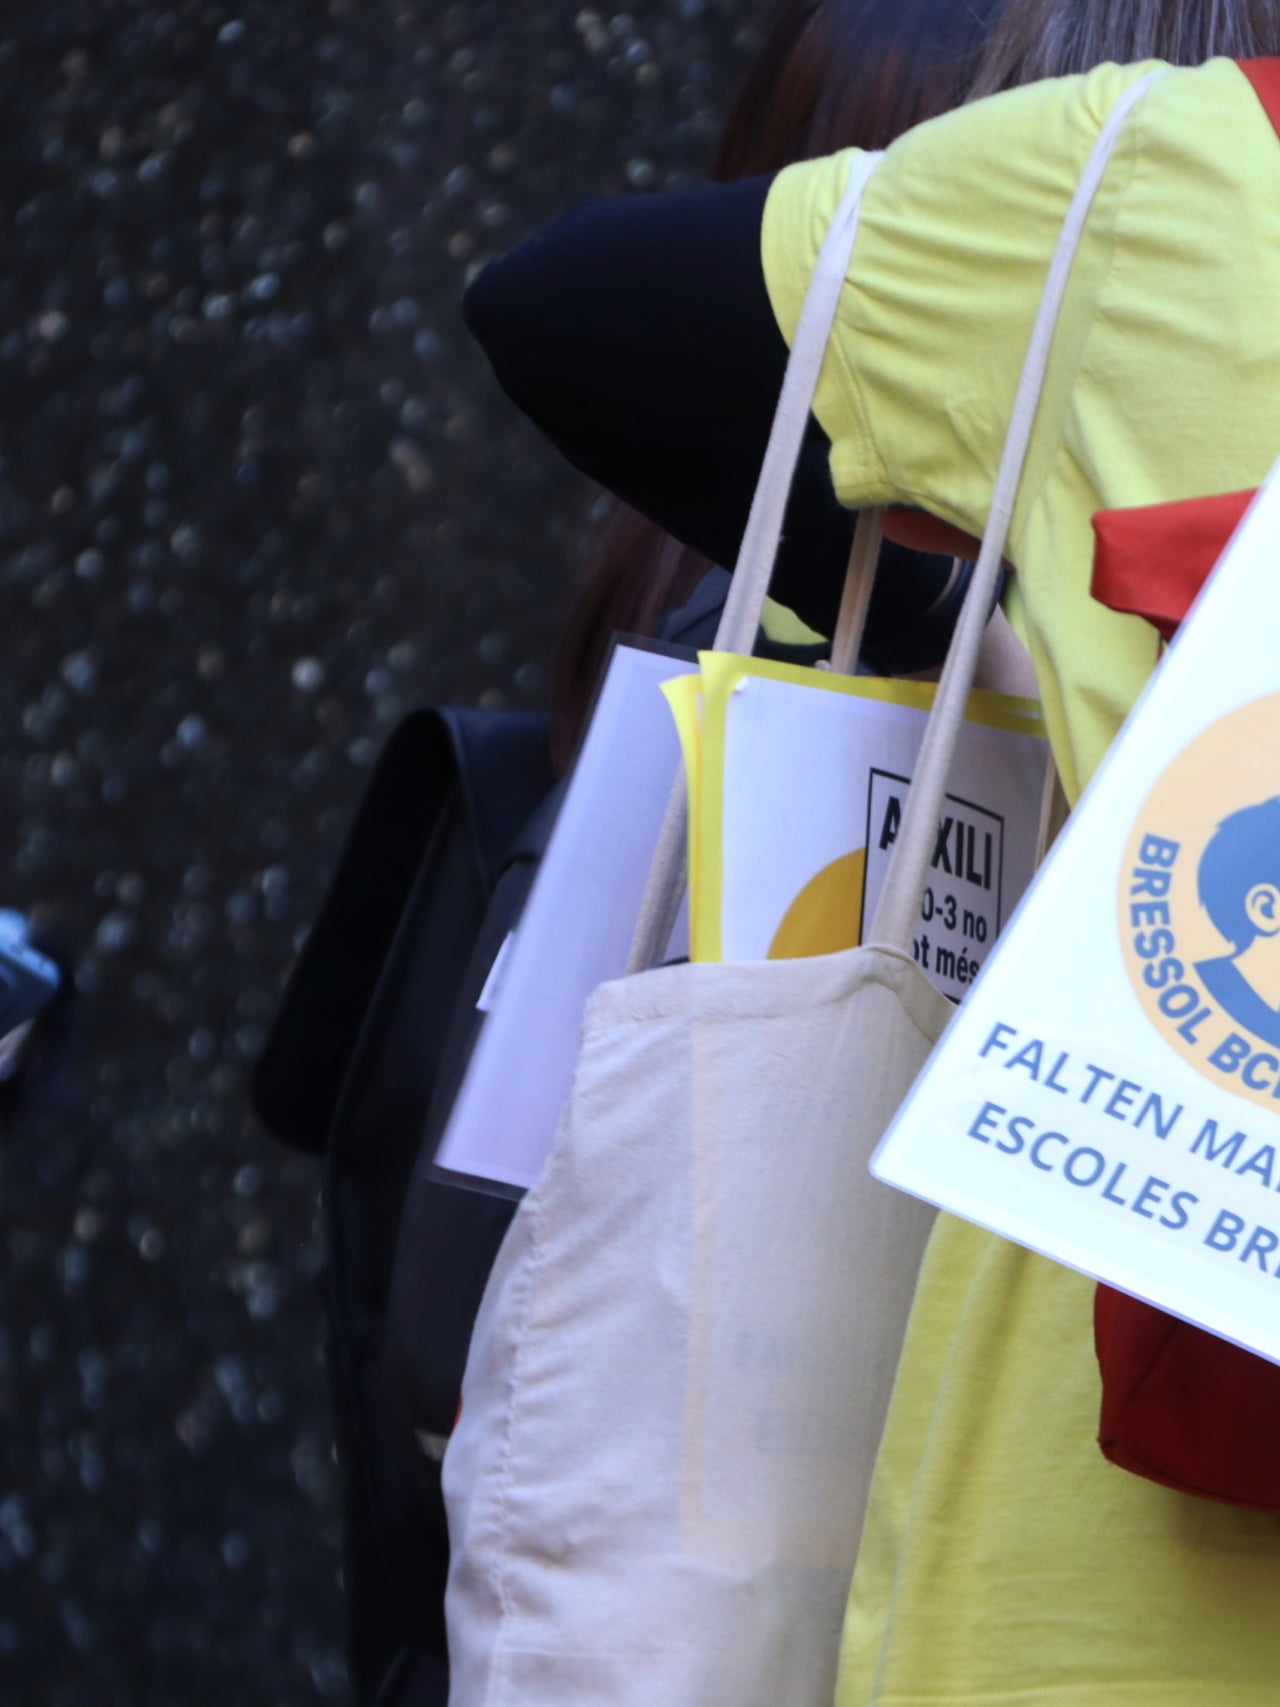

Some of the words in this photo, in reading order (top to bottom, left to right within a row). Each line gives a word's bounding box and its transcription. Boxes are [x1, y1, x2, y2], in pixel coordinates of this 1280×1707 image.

[879, 796, 992, 891] AXILI
[963, 909, 987, 943] no
[1130, 833, 1213, 1044] BRESSOL
[978, 1022, 1184, 1140] FALTEN
[967, 1101, 1198, 1230] ESCOLES
